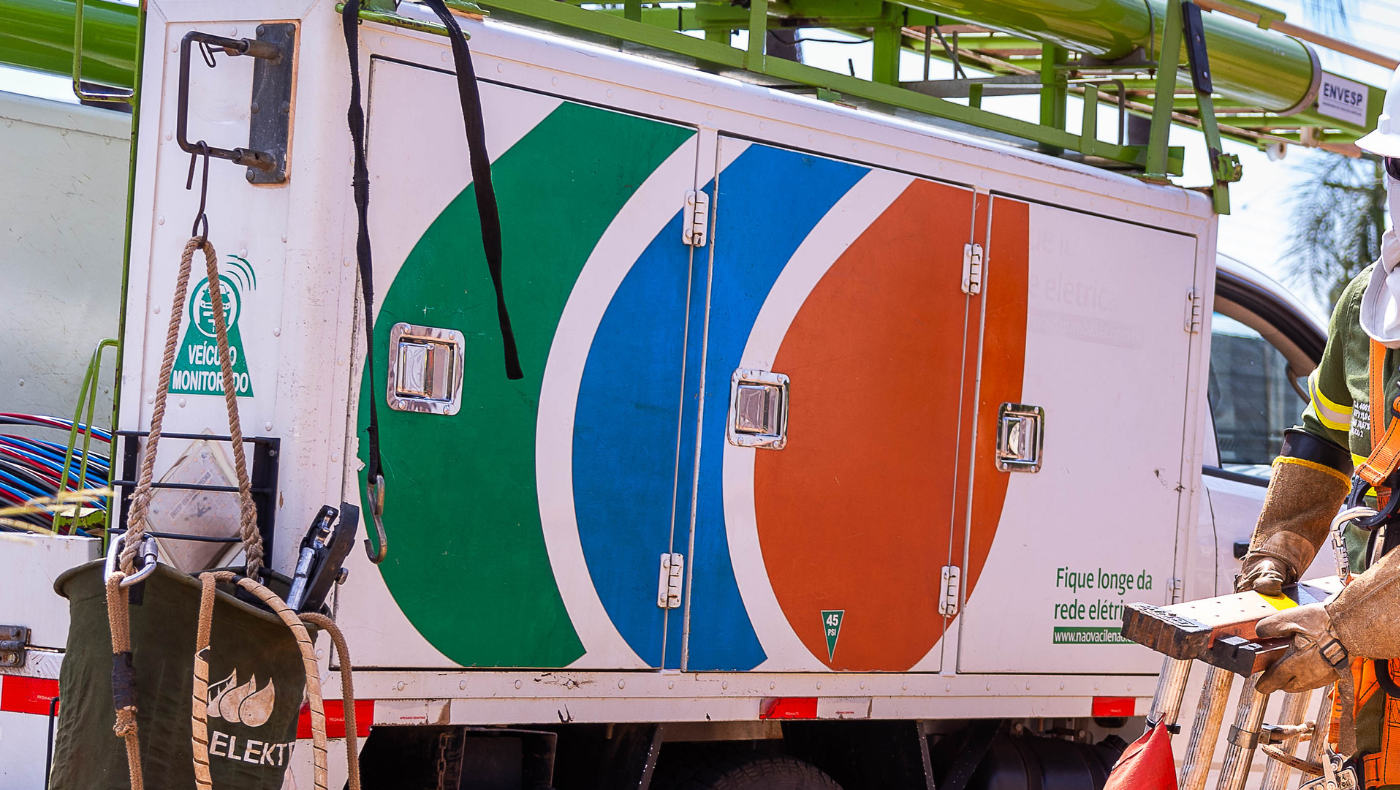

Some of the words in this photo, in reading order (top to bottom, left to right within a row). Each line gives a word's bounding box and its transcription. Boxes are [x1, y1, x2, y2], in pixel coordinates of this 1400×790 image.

[1323, 82, 1363, 106] ENVESP
[188, 341, 237, 366] VEÍCUO
[172, 370, 249, 393] MONITORDO
[1056, 566, 1094, 593] Fique
[1097, 568, 1134, 595] longe
[1137, 569, 1152, 590] da
[826, 614, 839, 626] 45
[1054, 599, 1085, 620] rede
[1089, 599, 1123, 620] elétri
[827, 628, 837, 637] PSI
[1054, 629, 1131, 643] www.naovacilenao.
[209, 730, 295, 766] ELEKT
